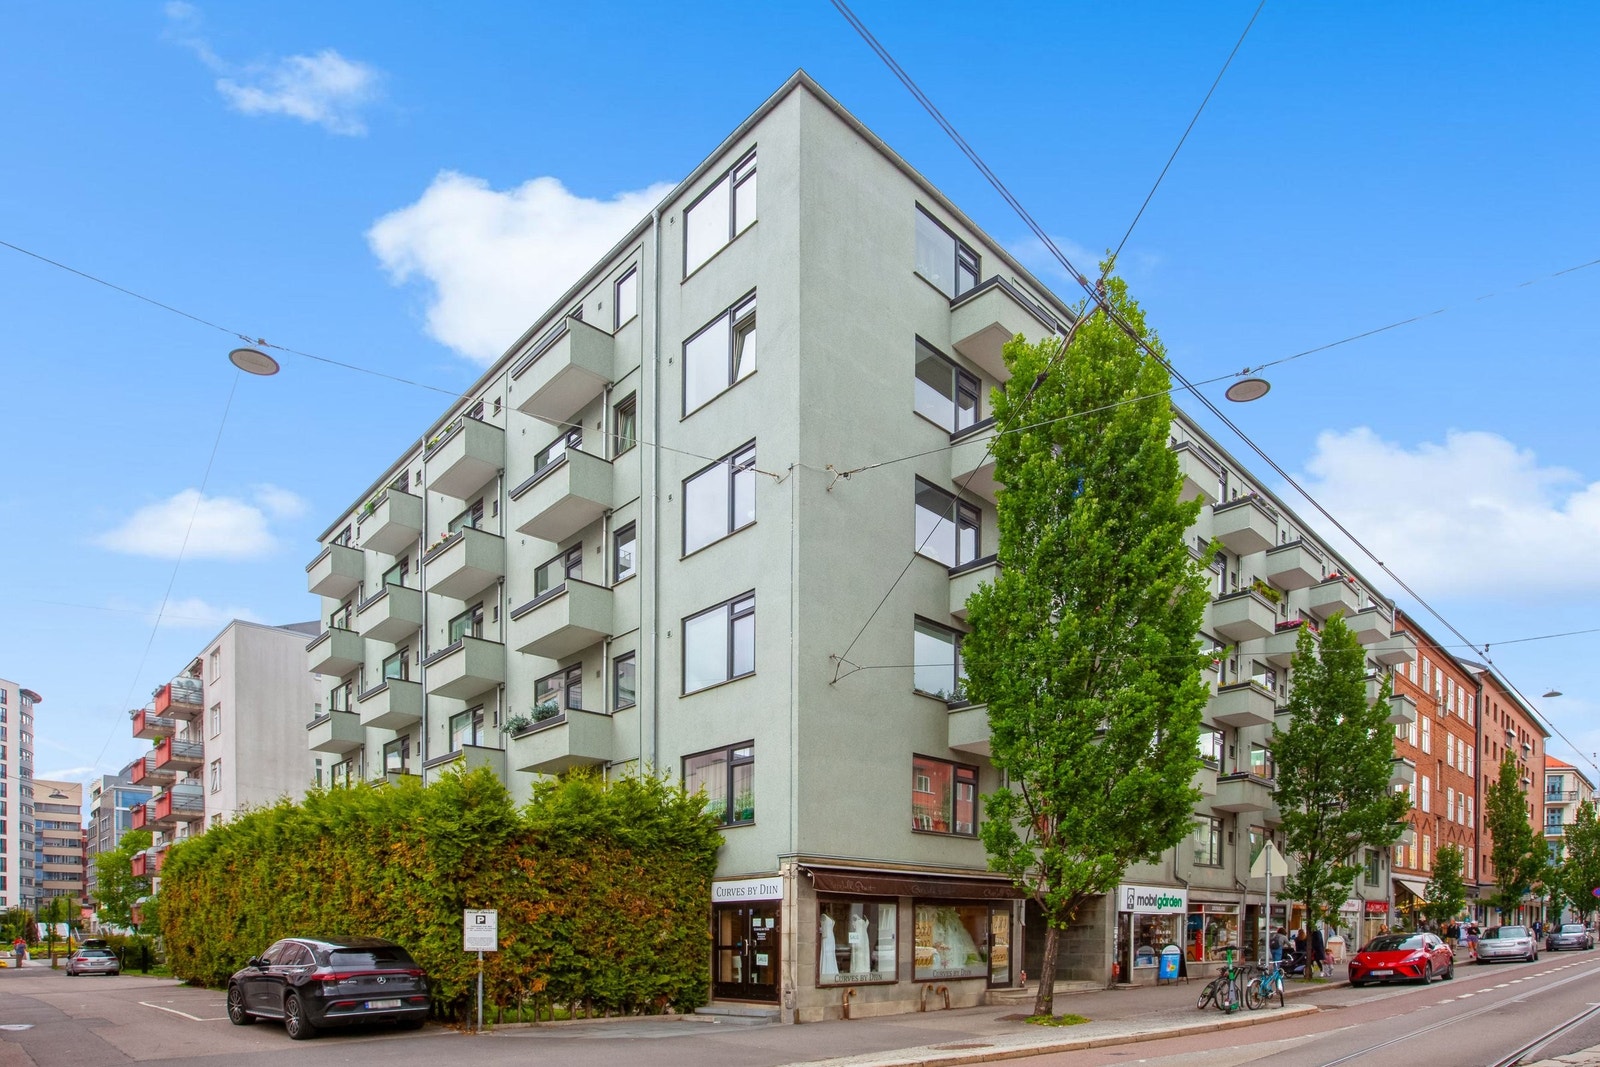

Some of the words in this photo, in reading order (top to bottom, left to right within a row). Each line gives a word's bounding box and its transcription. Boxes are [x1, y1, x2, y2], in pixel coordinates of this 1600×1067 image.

[716, 886, 745, 898] CURVES
[747, 886, 758, 896] BY
[759, 884, 778, 895] DIIN
[1136, 893, 1182, 909] mobilgården
[834, 974, 859, 983] CURVES
[859, 974, 869, 982] BY
